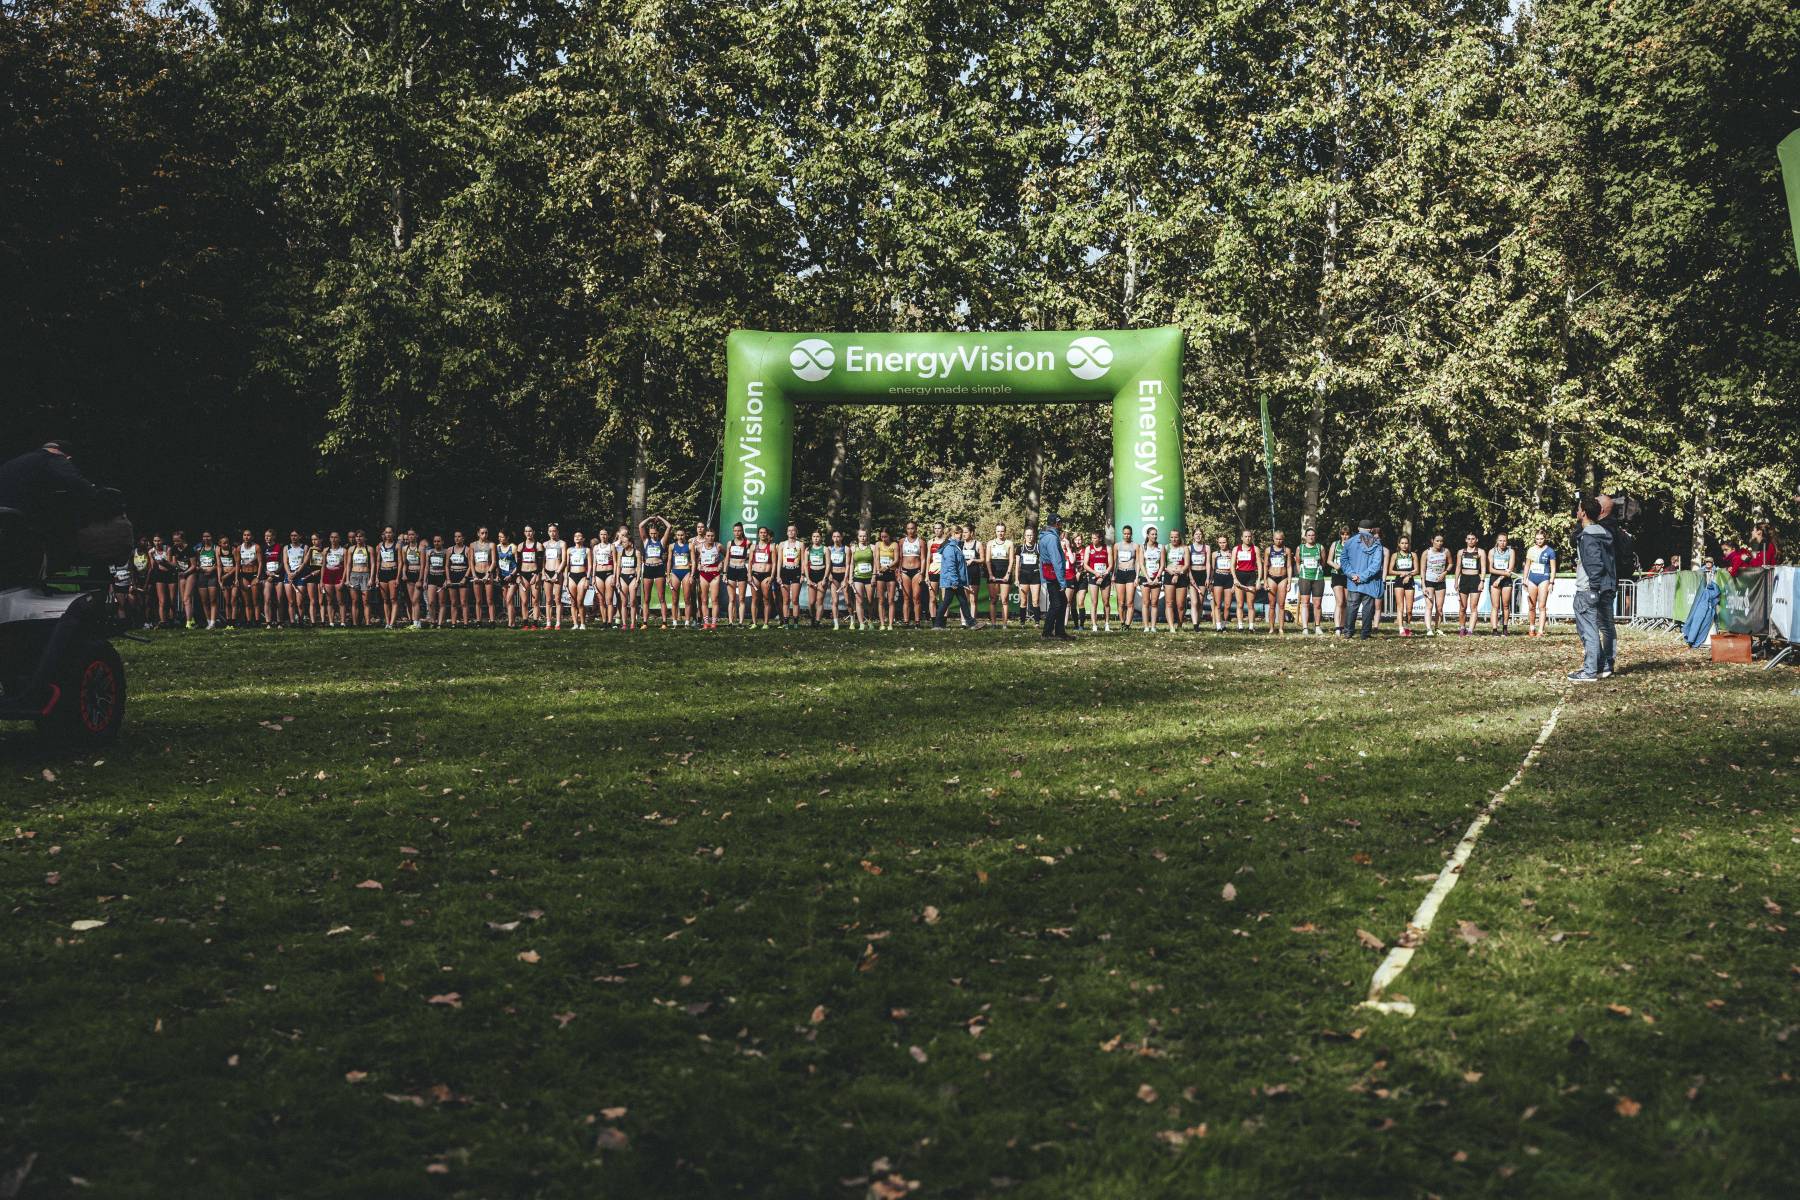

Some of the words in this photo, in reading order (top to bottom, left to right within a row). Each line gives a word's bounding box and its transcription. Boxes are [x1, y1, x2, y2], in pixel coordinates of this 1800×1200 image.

[846, 345, 1055, 379] EnergyVision
[888, 386, 931, 396] energy
[934, 385, 969, 394] made
[971, 384, 1012, 396] simple
[738, 381, 766, 545] nergyVision
